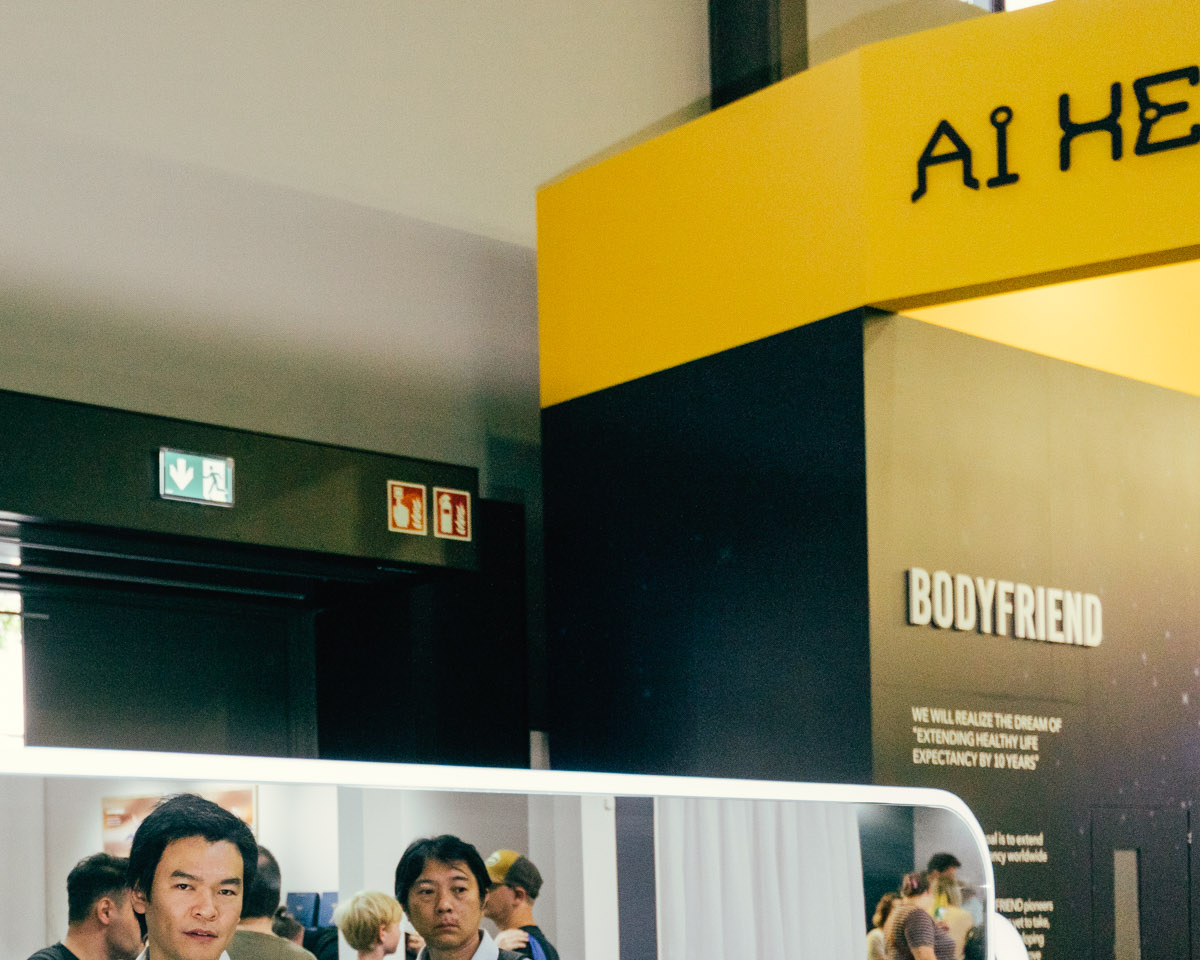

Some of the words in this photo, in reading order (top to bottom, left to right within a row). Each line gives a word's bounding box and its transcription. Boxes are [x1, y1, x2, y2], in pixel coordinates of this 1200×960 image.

[911, 106, 1019, 203] AI
[1059, 66, 1200, 171] HE
[907, 567, 1103, 647] BODYFRIEND
[912, 707, 929, 722] WE
[930, 708, 954, 725] WILL
[955, 710, 993, 728] REALIZE
[994, 712, 1013, 729] THE
[1014, 714, 1048, 731] DREAM
[1049, 717, 1062, 733] OF
[976, 732, 1019, 749] HEALTHY
[1019, 735, 1039, 751] LIFE
[913, 748, 977, 767] EXPECTANCY
[979, 752, 992, 767] BY
[994, 753, 1006, 768] 10
[1007, 848, 1048, 863] worldwide
